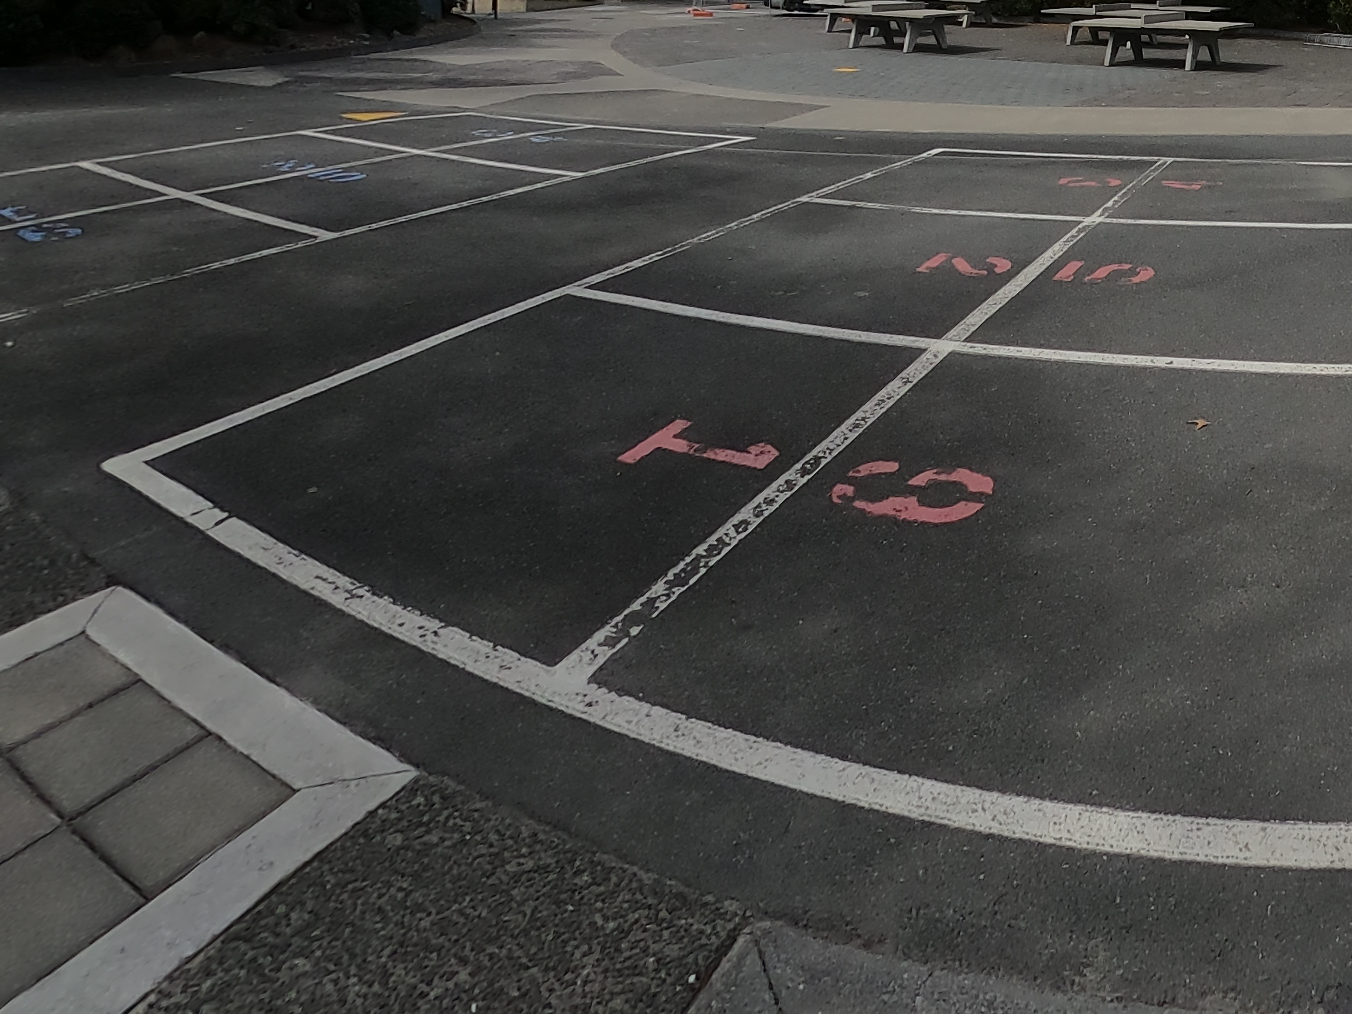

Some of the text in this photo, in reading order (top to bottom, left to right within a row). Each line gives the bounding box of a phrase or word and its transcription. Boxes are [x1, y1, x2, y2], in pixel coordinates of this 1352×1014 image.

[916, 252, 1012, 276] 2
[1052, 260, 1156, 285] 5
[616, 418, 780, 470] 1
